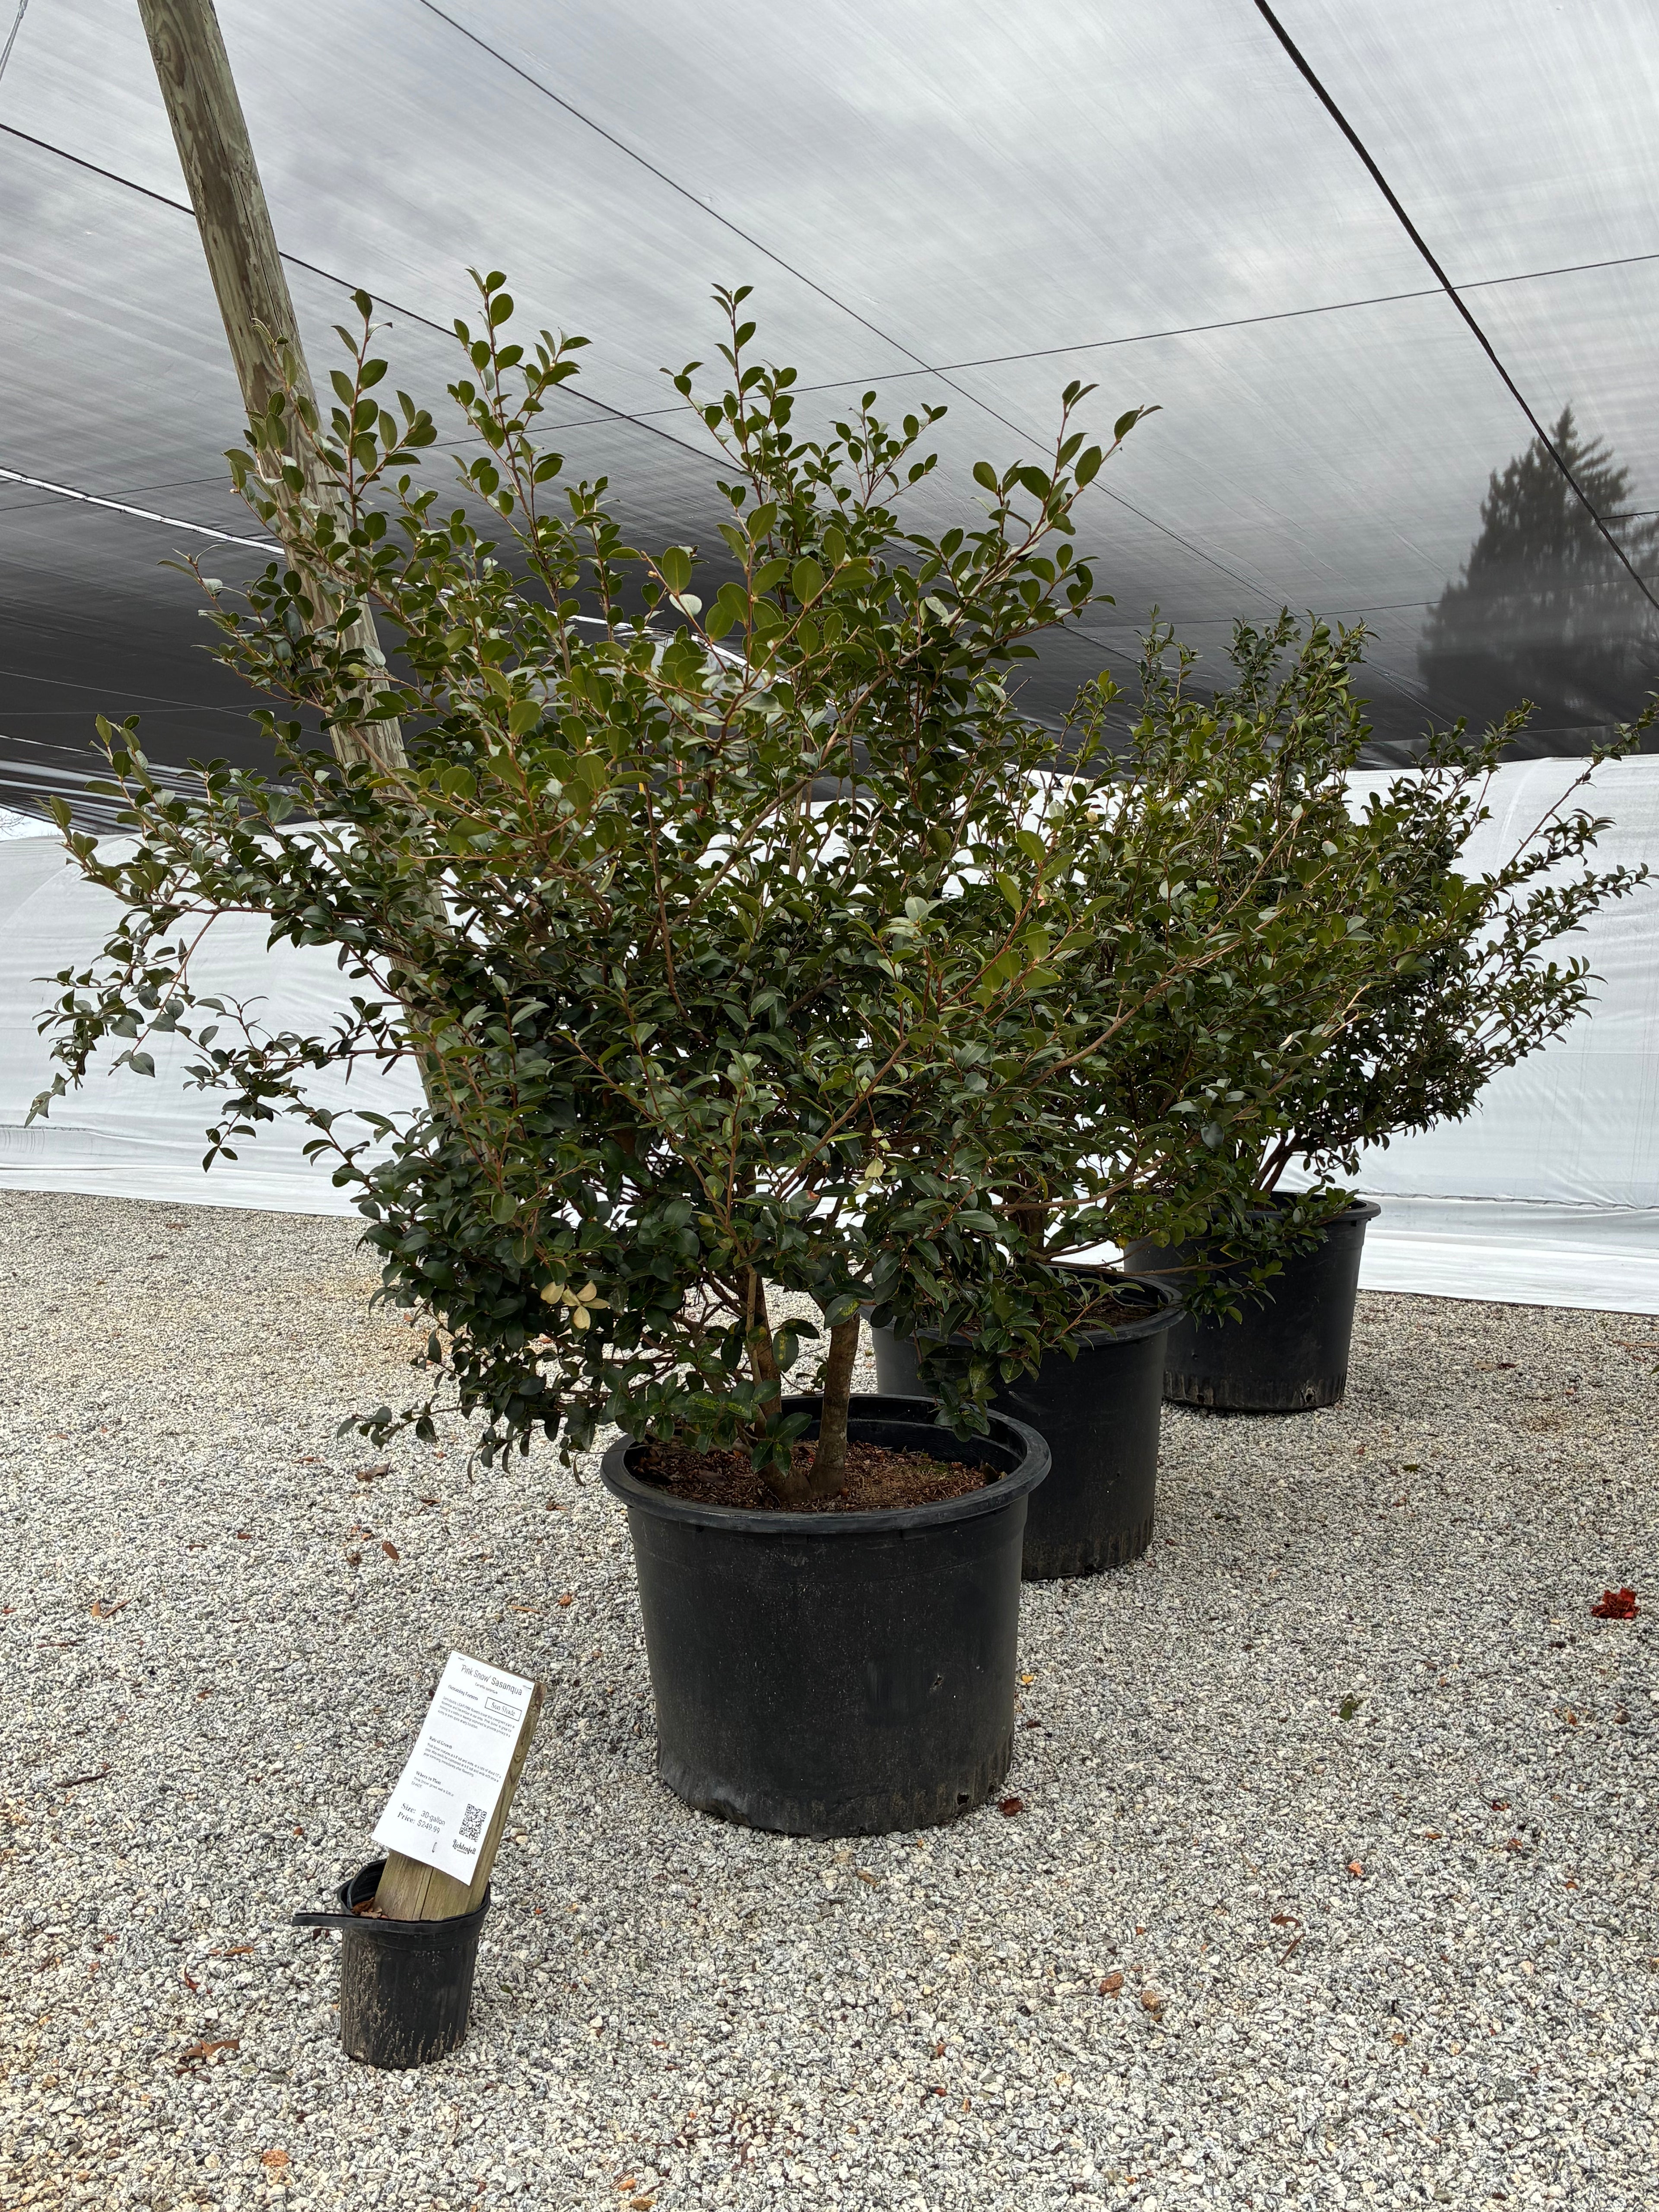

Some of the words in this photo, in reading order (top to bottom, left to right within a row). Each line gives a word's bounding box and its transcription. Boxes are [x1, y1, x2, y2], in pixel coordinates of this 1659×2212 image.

[491, 1677, 522, 1696] Sasanqua
[401, 1803, 416, 1814] Size:
[397, 1812, 416, 1824] Price:
[417, 1819, 440, 1834] $249.99
